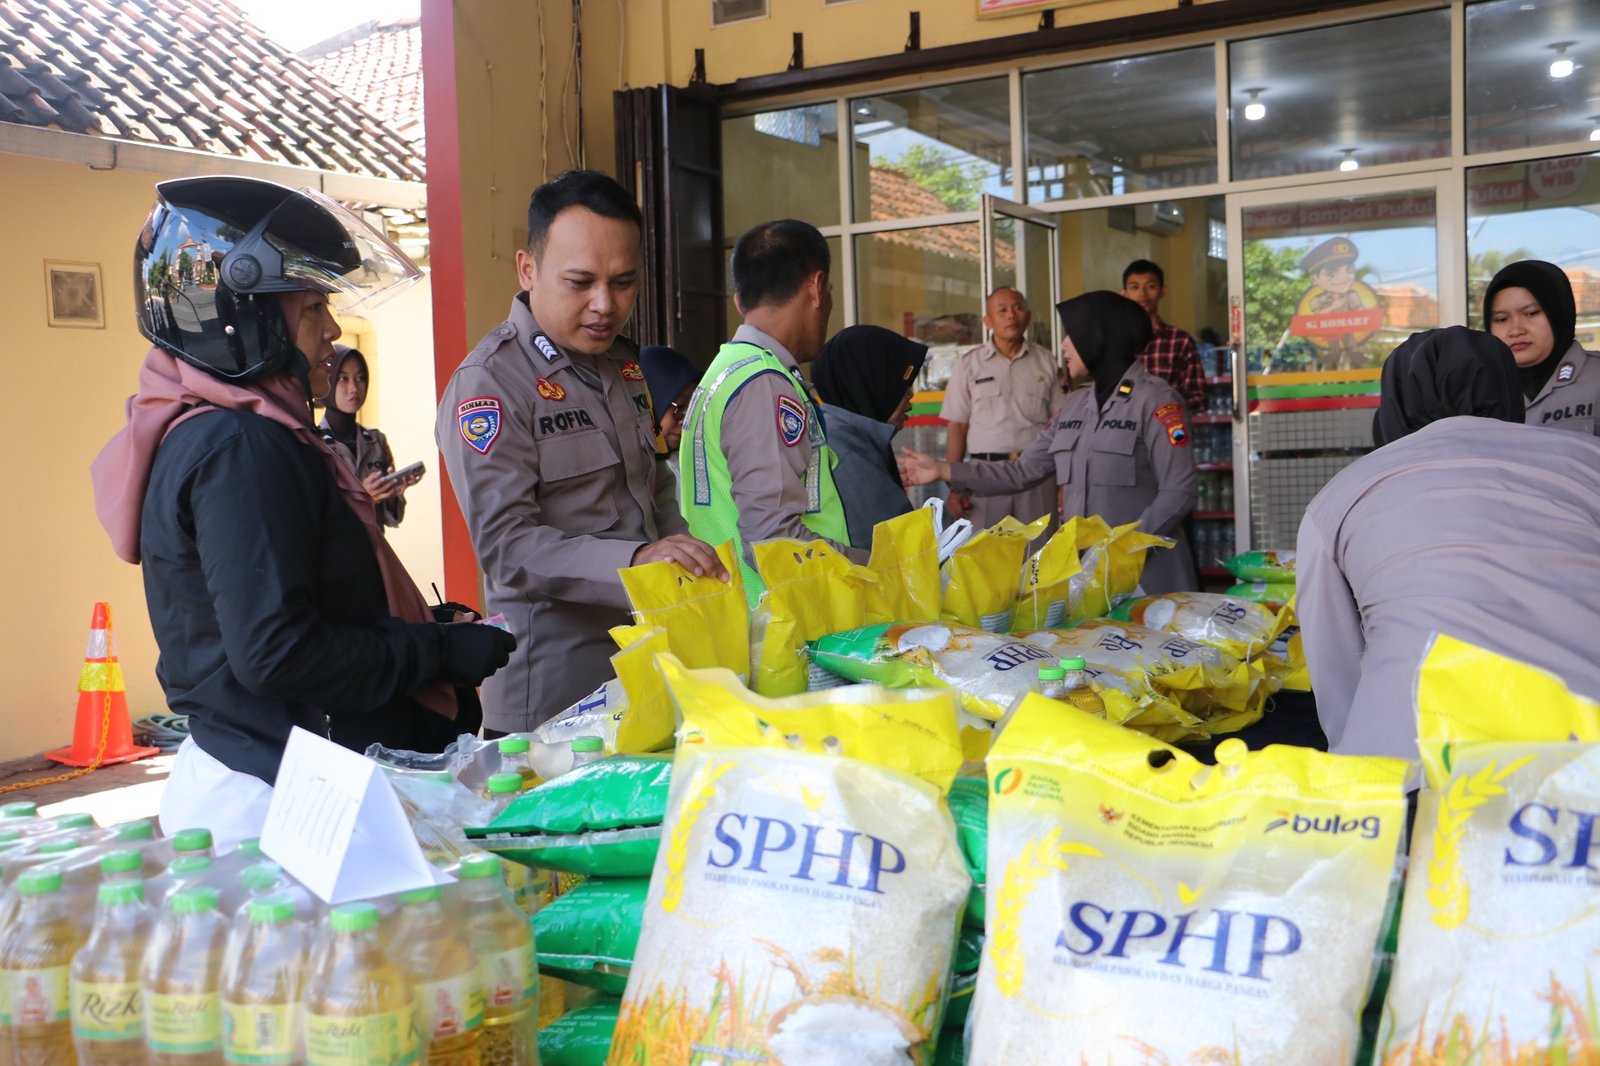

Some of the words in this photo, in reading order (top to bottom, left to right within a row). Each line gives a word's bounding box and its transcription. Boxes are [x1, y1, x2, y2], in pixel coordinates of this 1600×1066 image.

[1541, 170, 1576, 187] WIB
[1471, 183, 1523, 203] ukul
[1298, 204, 1372, 226] Sampai
[1378, 199, 1434, 217] Pukul
[539, 409, 594, 434] ROFIQ
[1102, 419, 1137, 431] POLRI
[1542, 403, 1593, 424] POLRI
[1292, 813, 1380, 839] bulog
[707, 812, 906, 895] SPHP
[1055, 901, 1302, 982] SPHP
[81, 989, 142, 1025] Rizk
